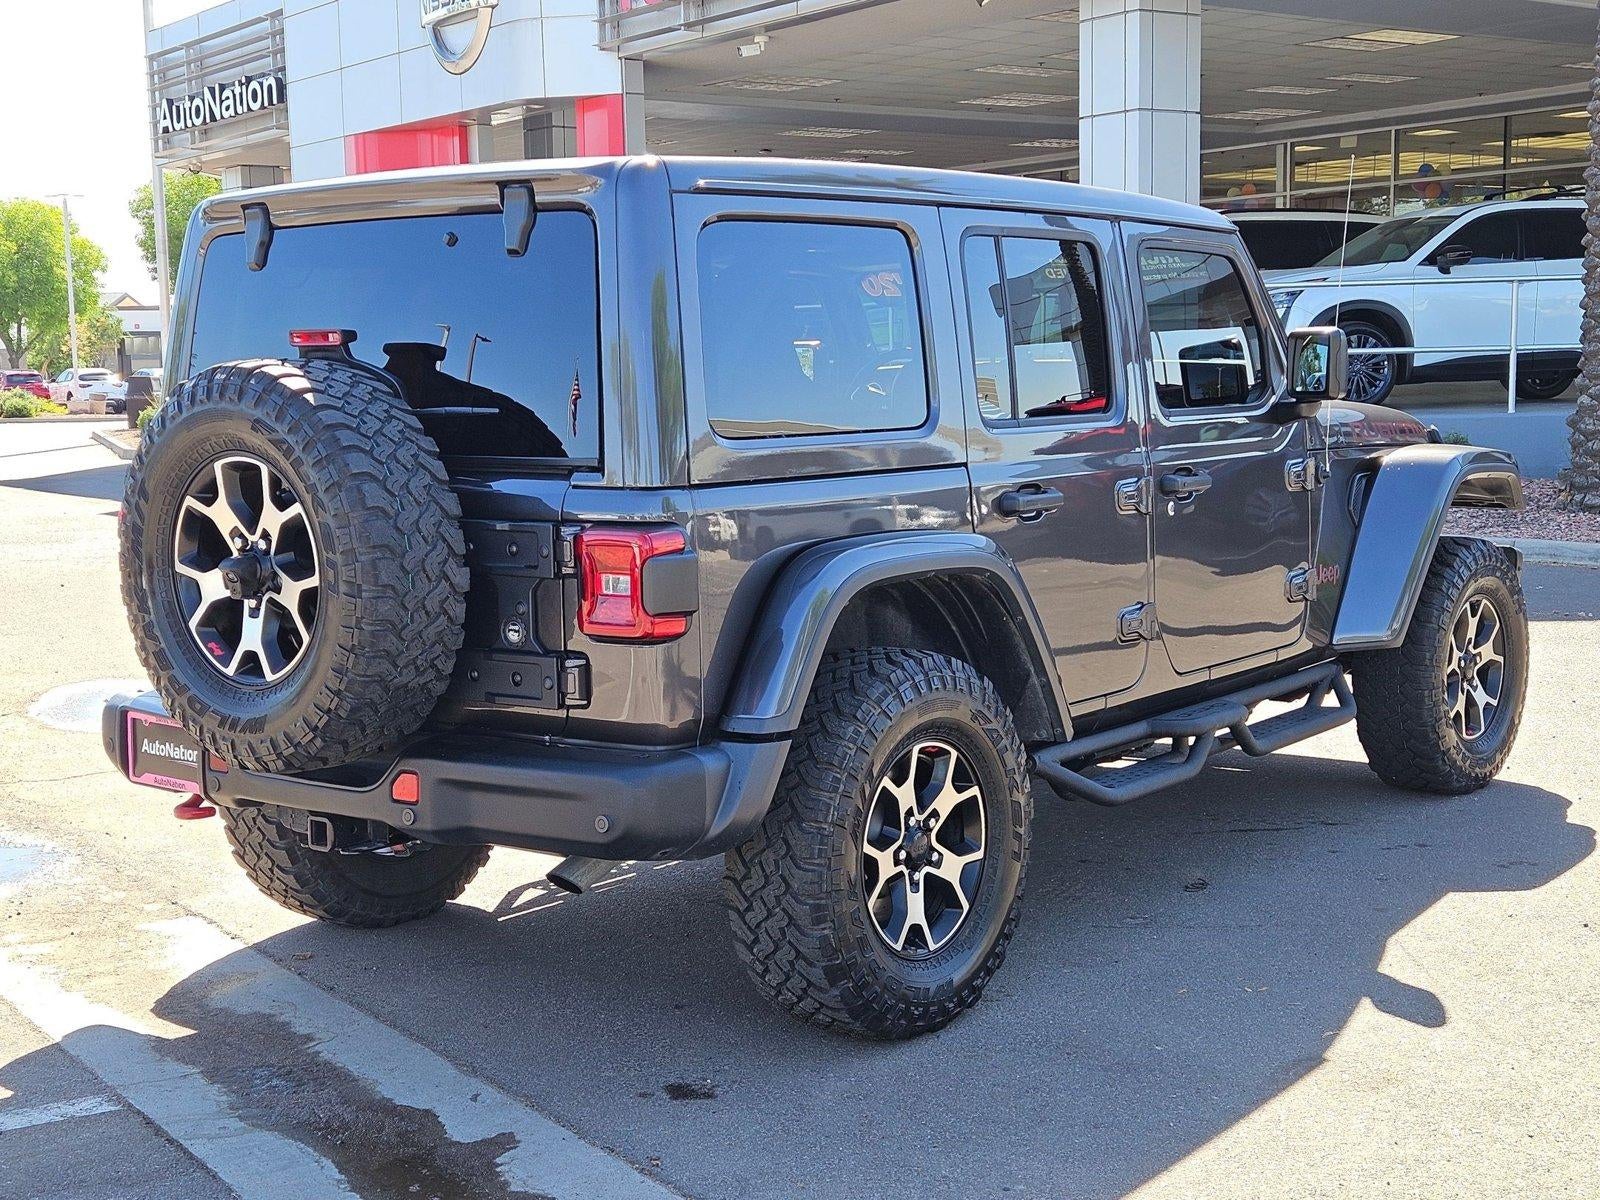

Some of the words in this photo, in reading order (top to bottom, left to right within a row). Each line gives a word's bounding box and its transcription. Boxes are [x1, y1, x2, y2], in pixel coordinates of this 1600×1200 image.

[159, 75, 278, 134] AutoNation
[1315, 564, 1340, 585] Jeep
[153, 776, 187, 790] AutoNation
